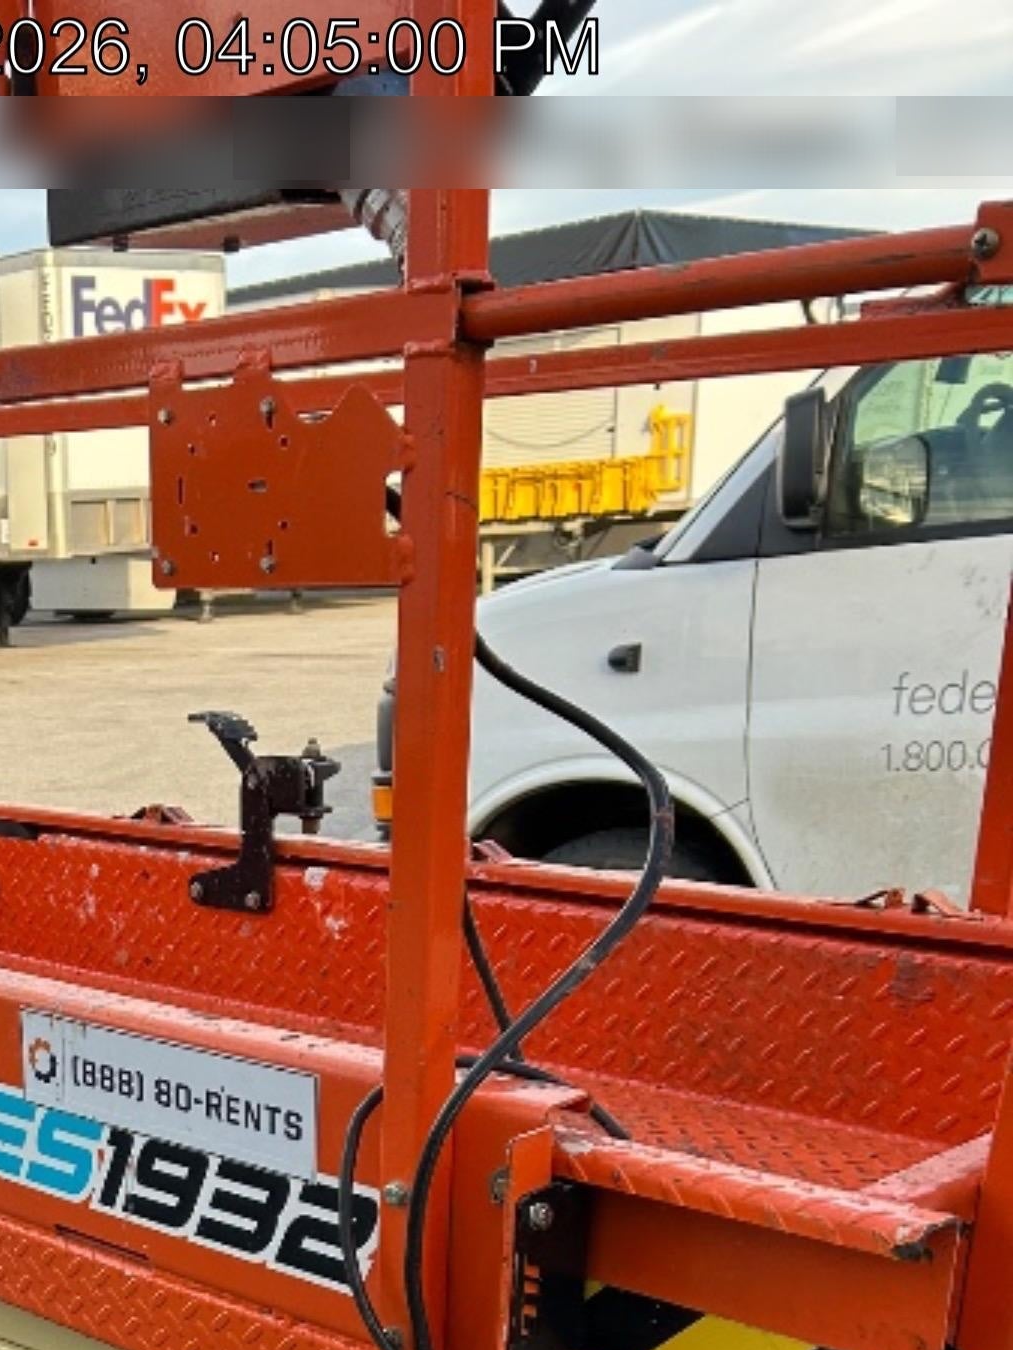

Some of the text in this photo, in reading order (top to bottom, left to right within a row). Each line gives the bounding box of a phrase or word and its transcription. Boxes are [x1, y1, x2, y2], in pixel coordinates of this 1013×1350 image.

[892, 669, 996, 715] fede
[71, 1054, 303, 1142] (888) 80-RENTS
